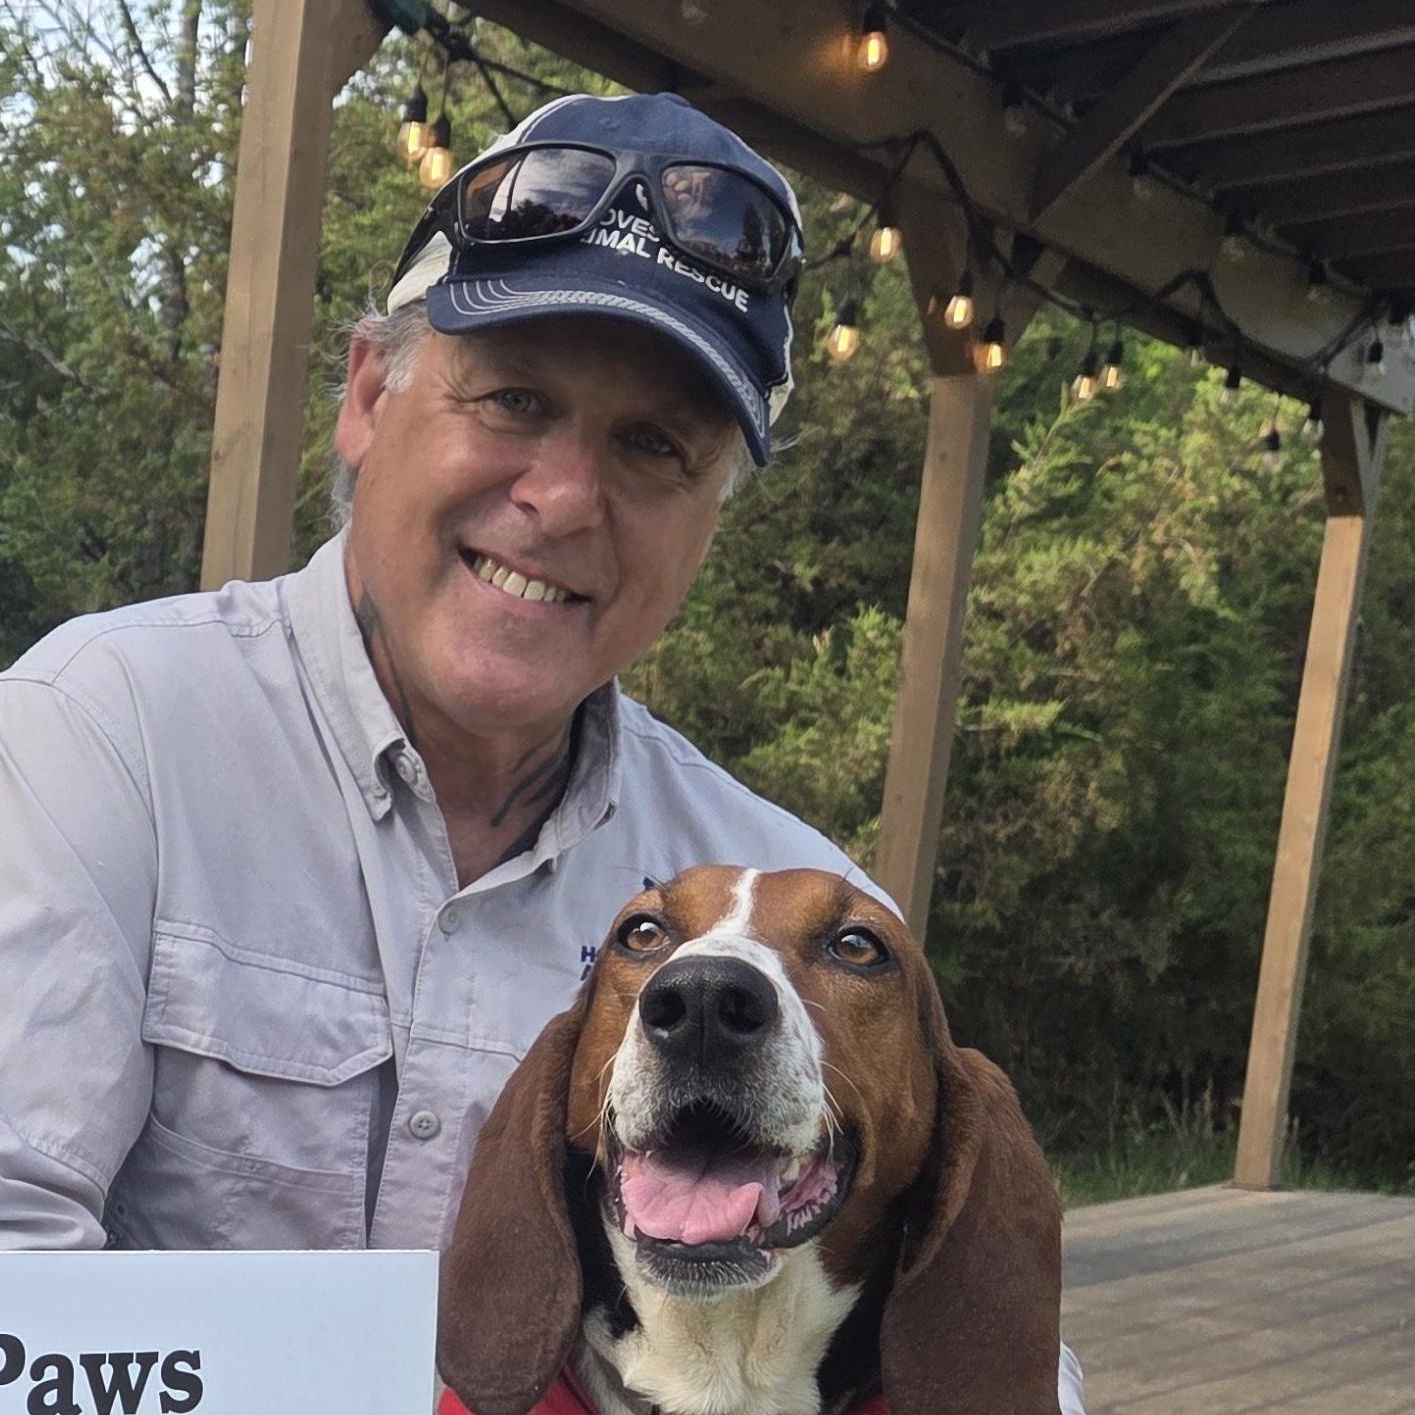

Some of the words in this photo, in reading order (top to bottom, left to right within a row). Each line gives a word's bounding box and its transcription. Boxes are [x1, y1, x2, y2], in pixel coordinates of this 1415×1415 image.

[600, 208, 660, 242] OVES
[581, 228, 651, 258] IMAL
[656, 246, 750, 313] RESCUE
